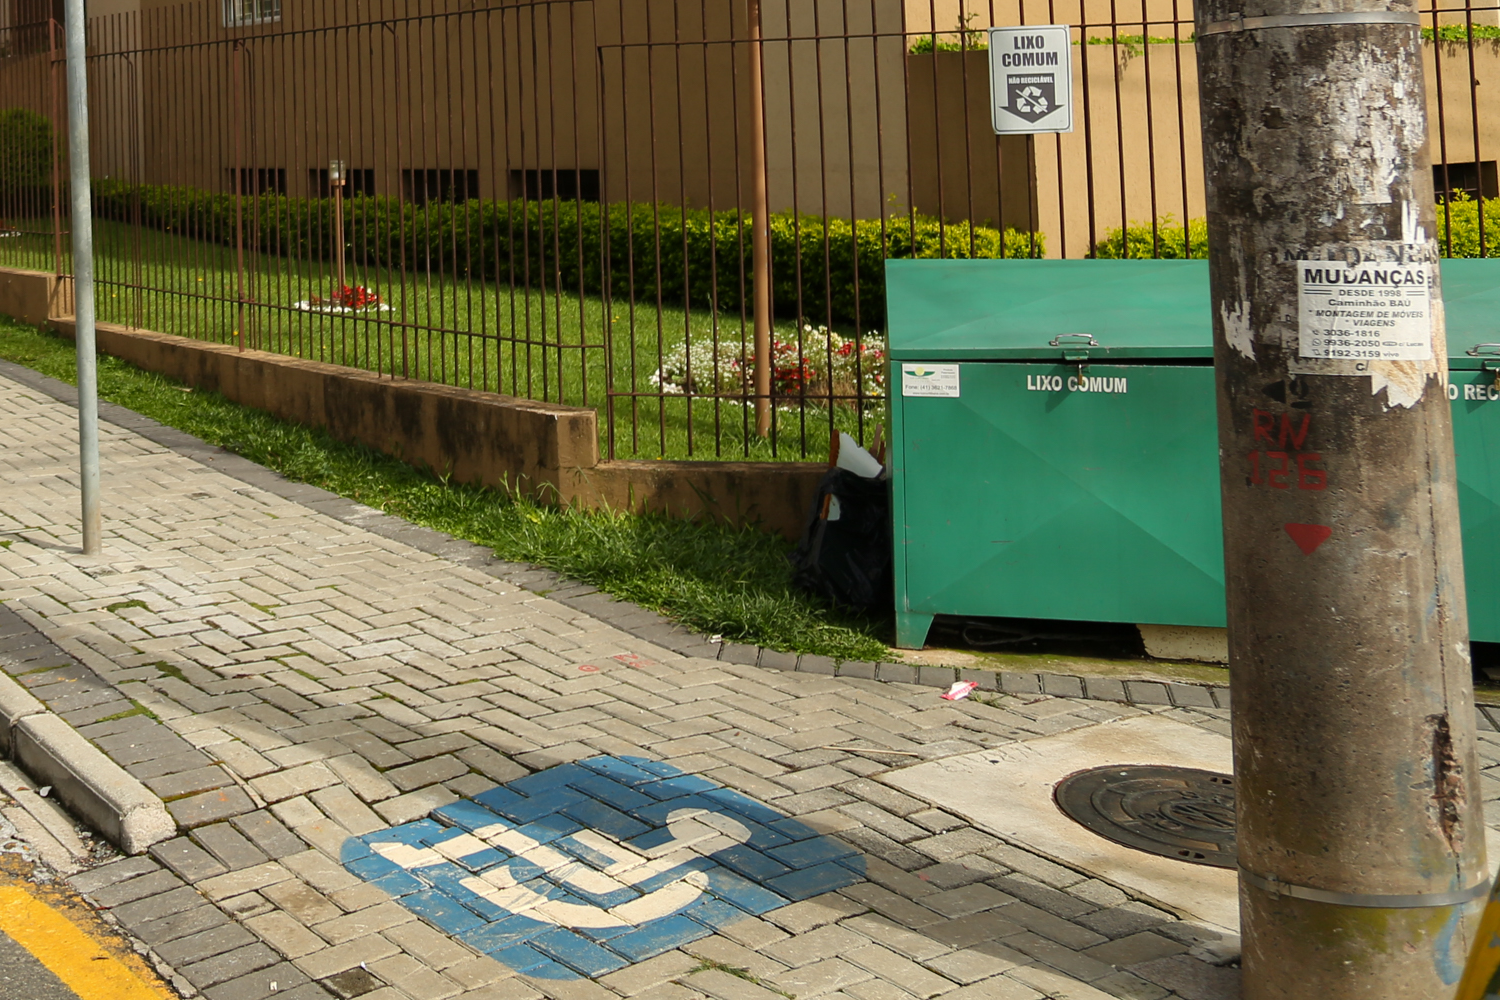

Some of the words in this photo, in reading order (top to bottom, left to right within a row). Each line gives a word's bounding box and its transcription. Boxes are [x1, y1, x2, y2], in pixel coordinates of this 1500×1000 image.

[1013, 35, 1045, 50] LIXO
[1002, 52, 1058, 67] COMUM
[1304, 268, 1425, 289] MUDANÇAS
[1339, 289, 1375, 297] DESDE
[1378, 289, 1402, 297] 1998
[1328, 298, 1386, 307] Caminhão
[1389, 299, 1411, 307] BAÚ
[1315, 310, 1374, 318] MONTAGEM
[1392, 310, 1424, 318] MÓVEIS
[1323, 329, 1381, 337] 3036-1816
[1323, 339, 1381, 347] 9936-2050
[1027, 375, 1063, 392] LIXO
[1067, 375, 1128, 393] COMUM
[1252, 407, 1312, 450] RN
[1248, 452, 1328, 491] 126
